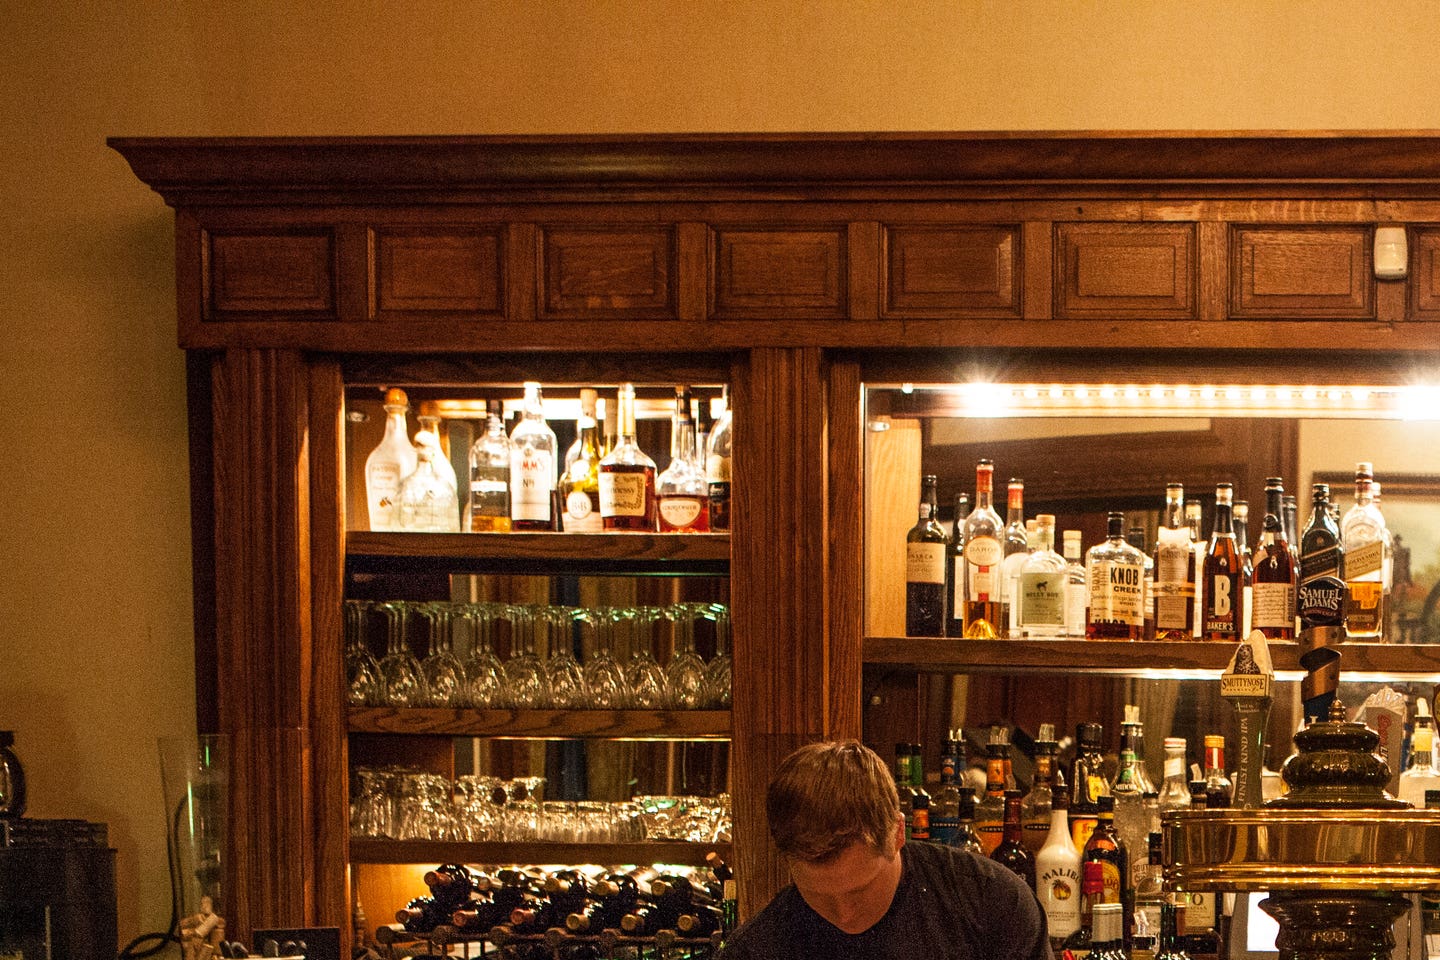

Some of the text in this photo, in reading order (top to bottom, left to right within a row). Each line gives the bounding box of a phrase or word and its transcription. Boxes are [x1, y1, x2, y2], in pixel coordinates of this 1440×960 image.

[1110, 567, 1139, 586] KNOB
[1113, 586, 1141, 594] CREEK
[1214, 574, 1230, 616] B
[1300, 586, 1342, 601] SAMUEL
[1301, 598, 1339, 610] ADAMS
[1207, 621, 1234, 631] BAKER'S
[1222, 676, 1265, 690] SMUTTYNOSE
[1240, 737, 1248, 764] KIND
[1237, 767, 1249, 802] FINEST
